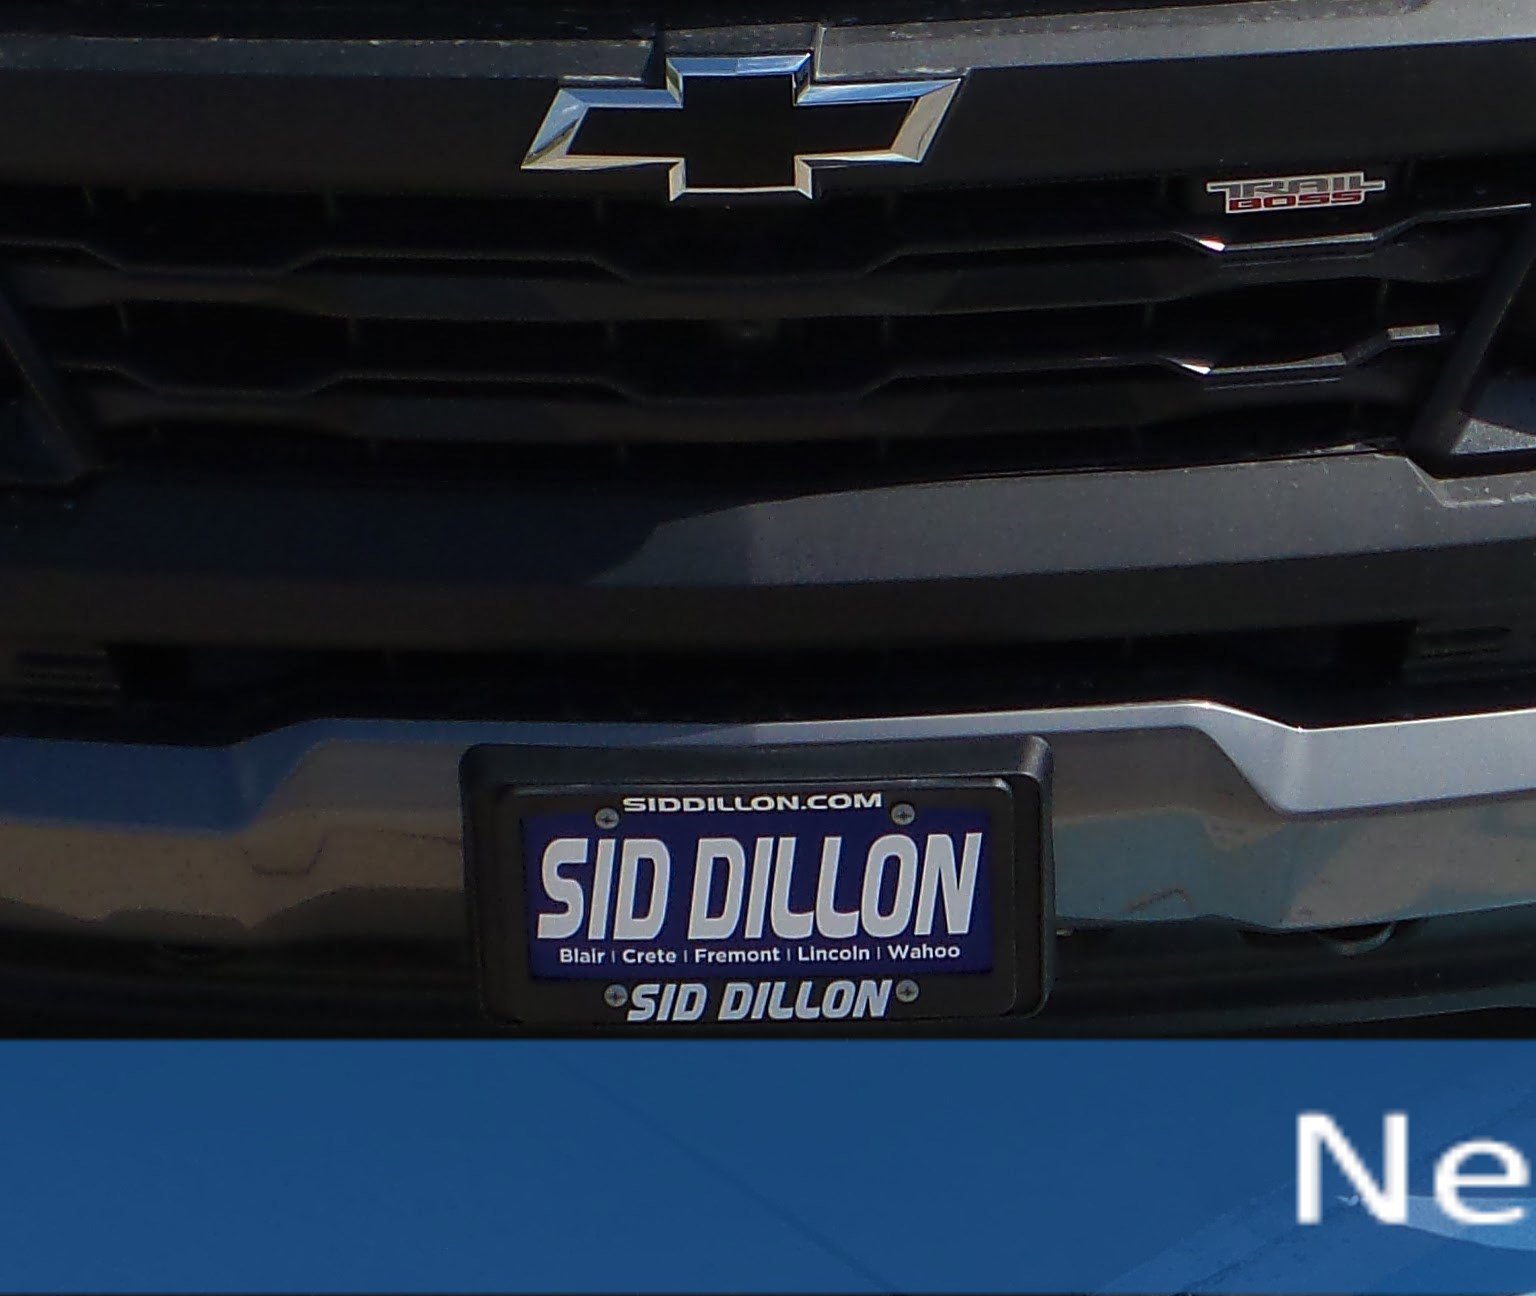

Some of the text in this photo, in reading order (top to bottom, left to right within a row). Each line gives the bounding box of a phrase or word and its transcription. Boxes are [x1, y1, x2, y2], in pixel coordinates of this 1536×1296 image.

[1207, 171, 1386, 200] TRAIL
[1226, 191, 1363, 213] BOSS
[622, 793, 882, 813] SIDDILLON.COM
[537, 832, 983, 940] SID DILLON
[559, 943, 961, 964] Blair Crete Fremont Lincoln Wahoo
[626, 979, 893, 1022] SID DILLON
